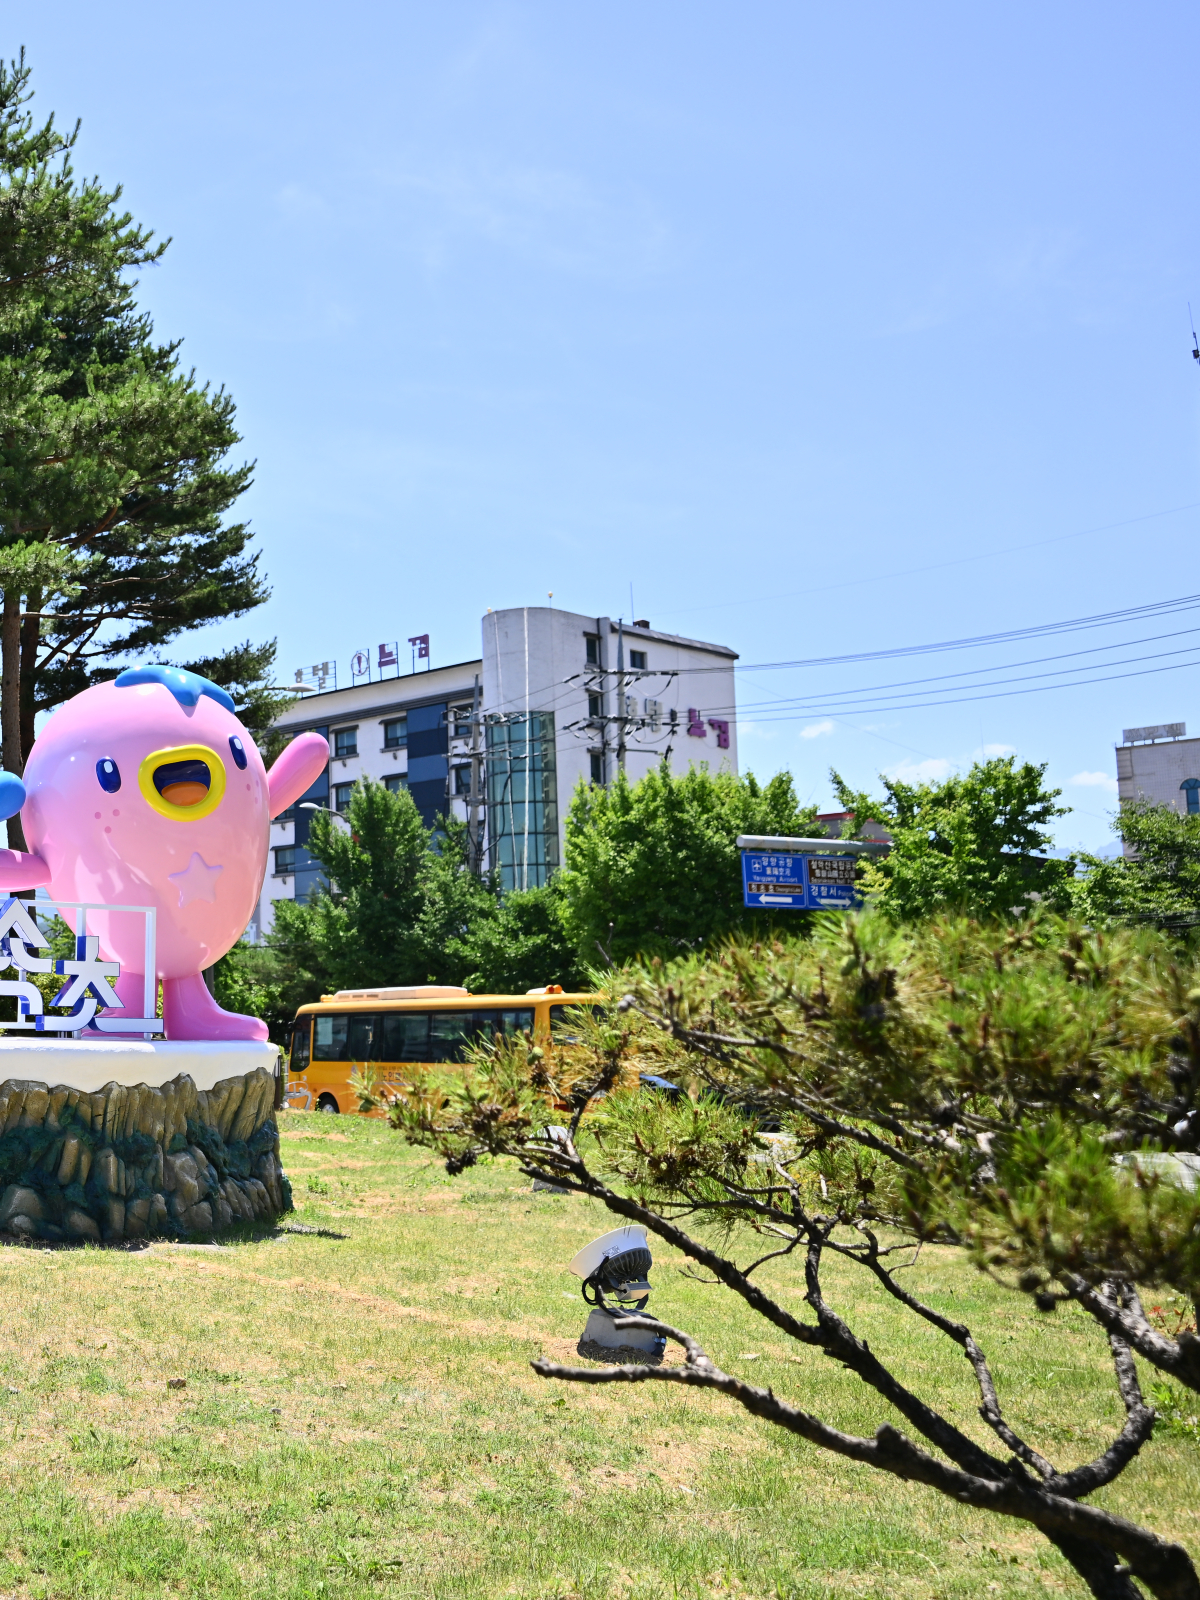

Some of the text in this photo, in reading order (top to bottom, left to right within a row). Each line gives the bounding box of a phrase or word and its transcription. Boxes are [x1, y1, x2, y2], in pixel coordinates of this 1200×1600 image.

[761, 856, 793, 867] 양양공항
[752, 875, 777, 883] Yangyang
[810, 885, 837, 897] 경찰서
